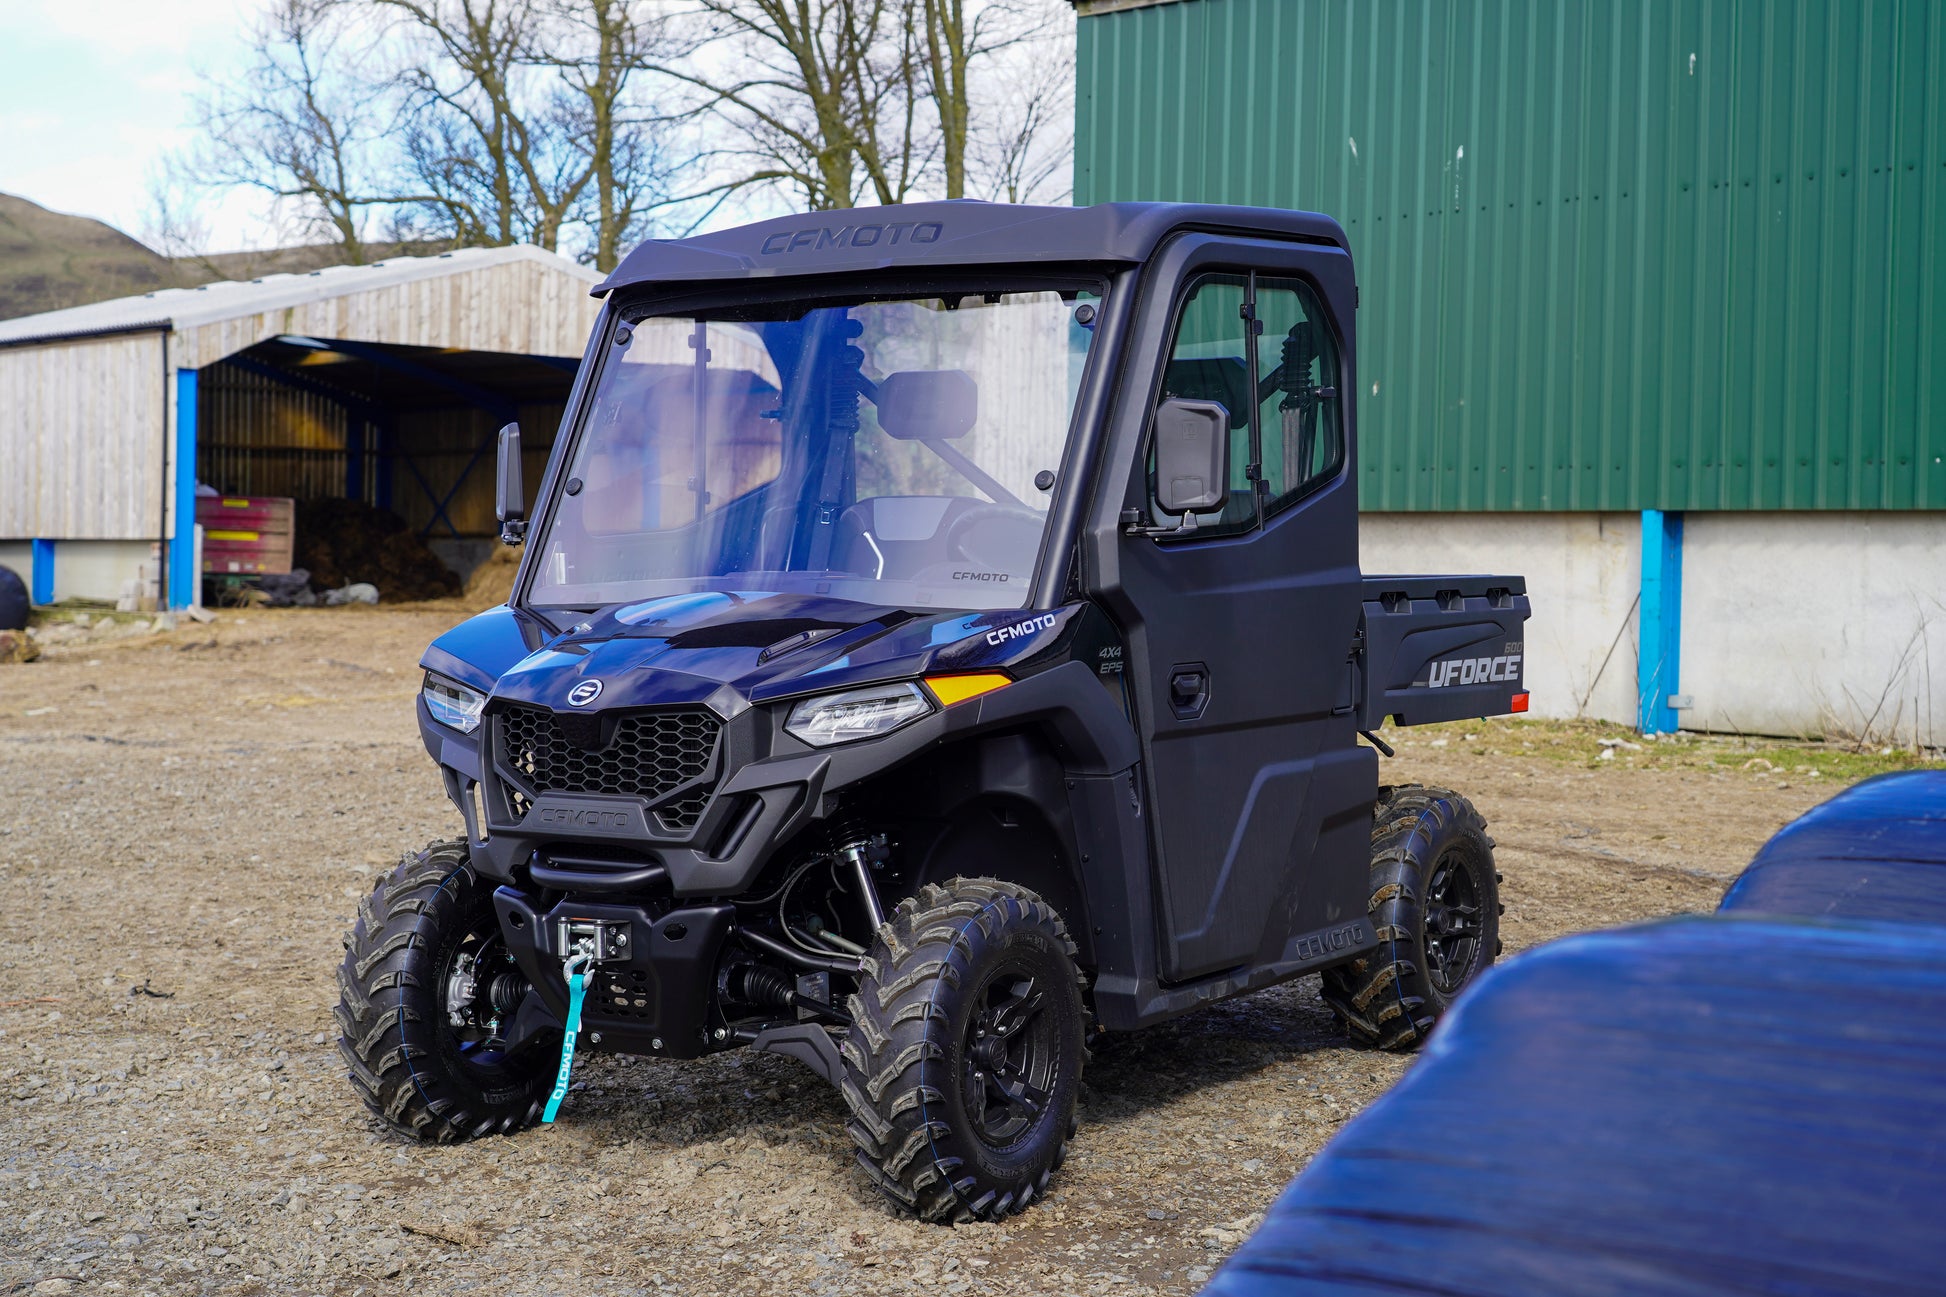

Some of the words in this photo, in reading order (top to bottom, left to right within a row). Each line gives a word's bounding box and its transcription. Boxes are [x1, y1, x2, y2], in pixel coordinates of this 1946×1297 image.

[760, 221, 943, 255] CFMOTO
[952, 571, 1009, 582] CFMOTO
[986, 613, 1056, 646] CFMOTO
[1504, 641, 1523, 654] 600
[1100, 661, 1123, 674] EPS
[1428, 655, 1521, 688] UFORCE
[540, 808, 629, 826] CFMOTO
[1296, 924, 1363, 960] CFMOTO
[552, 1030, 575, 1100] CFMOTO
